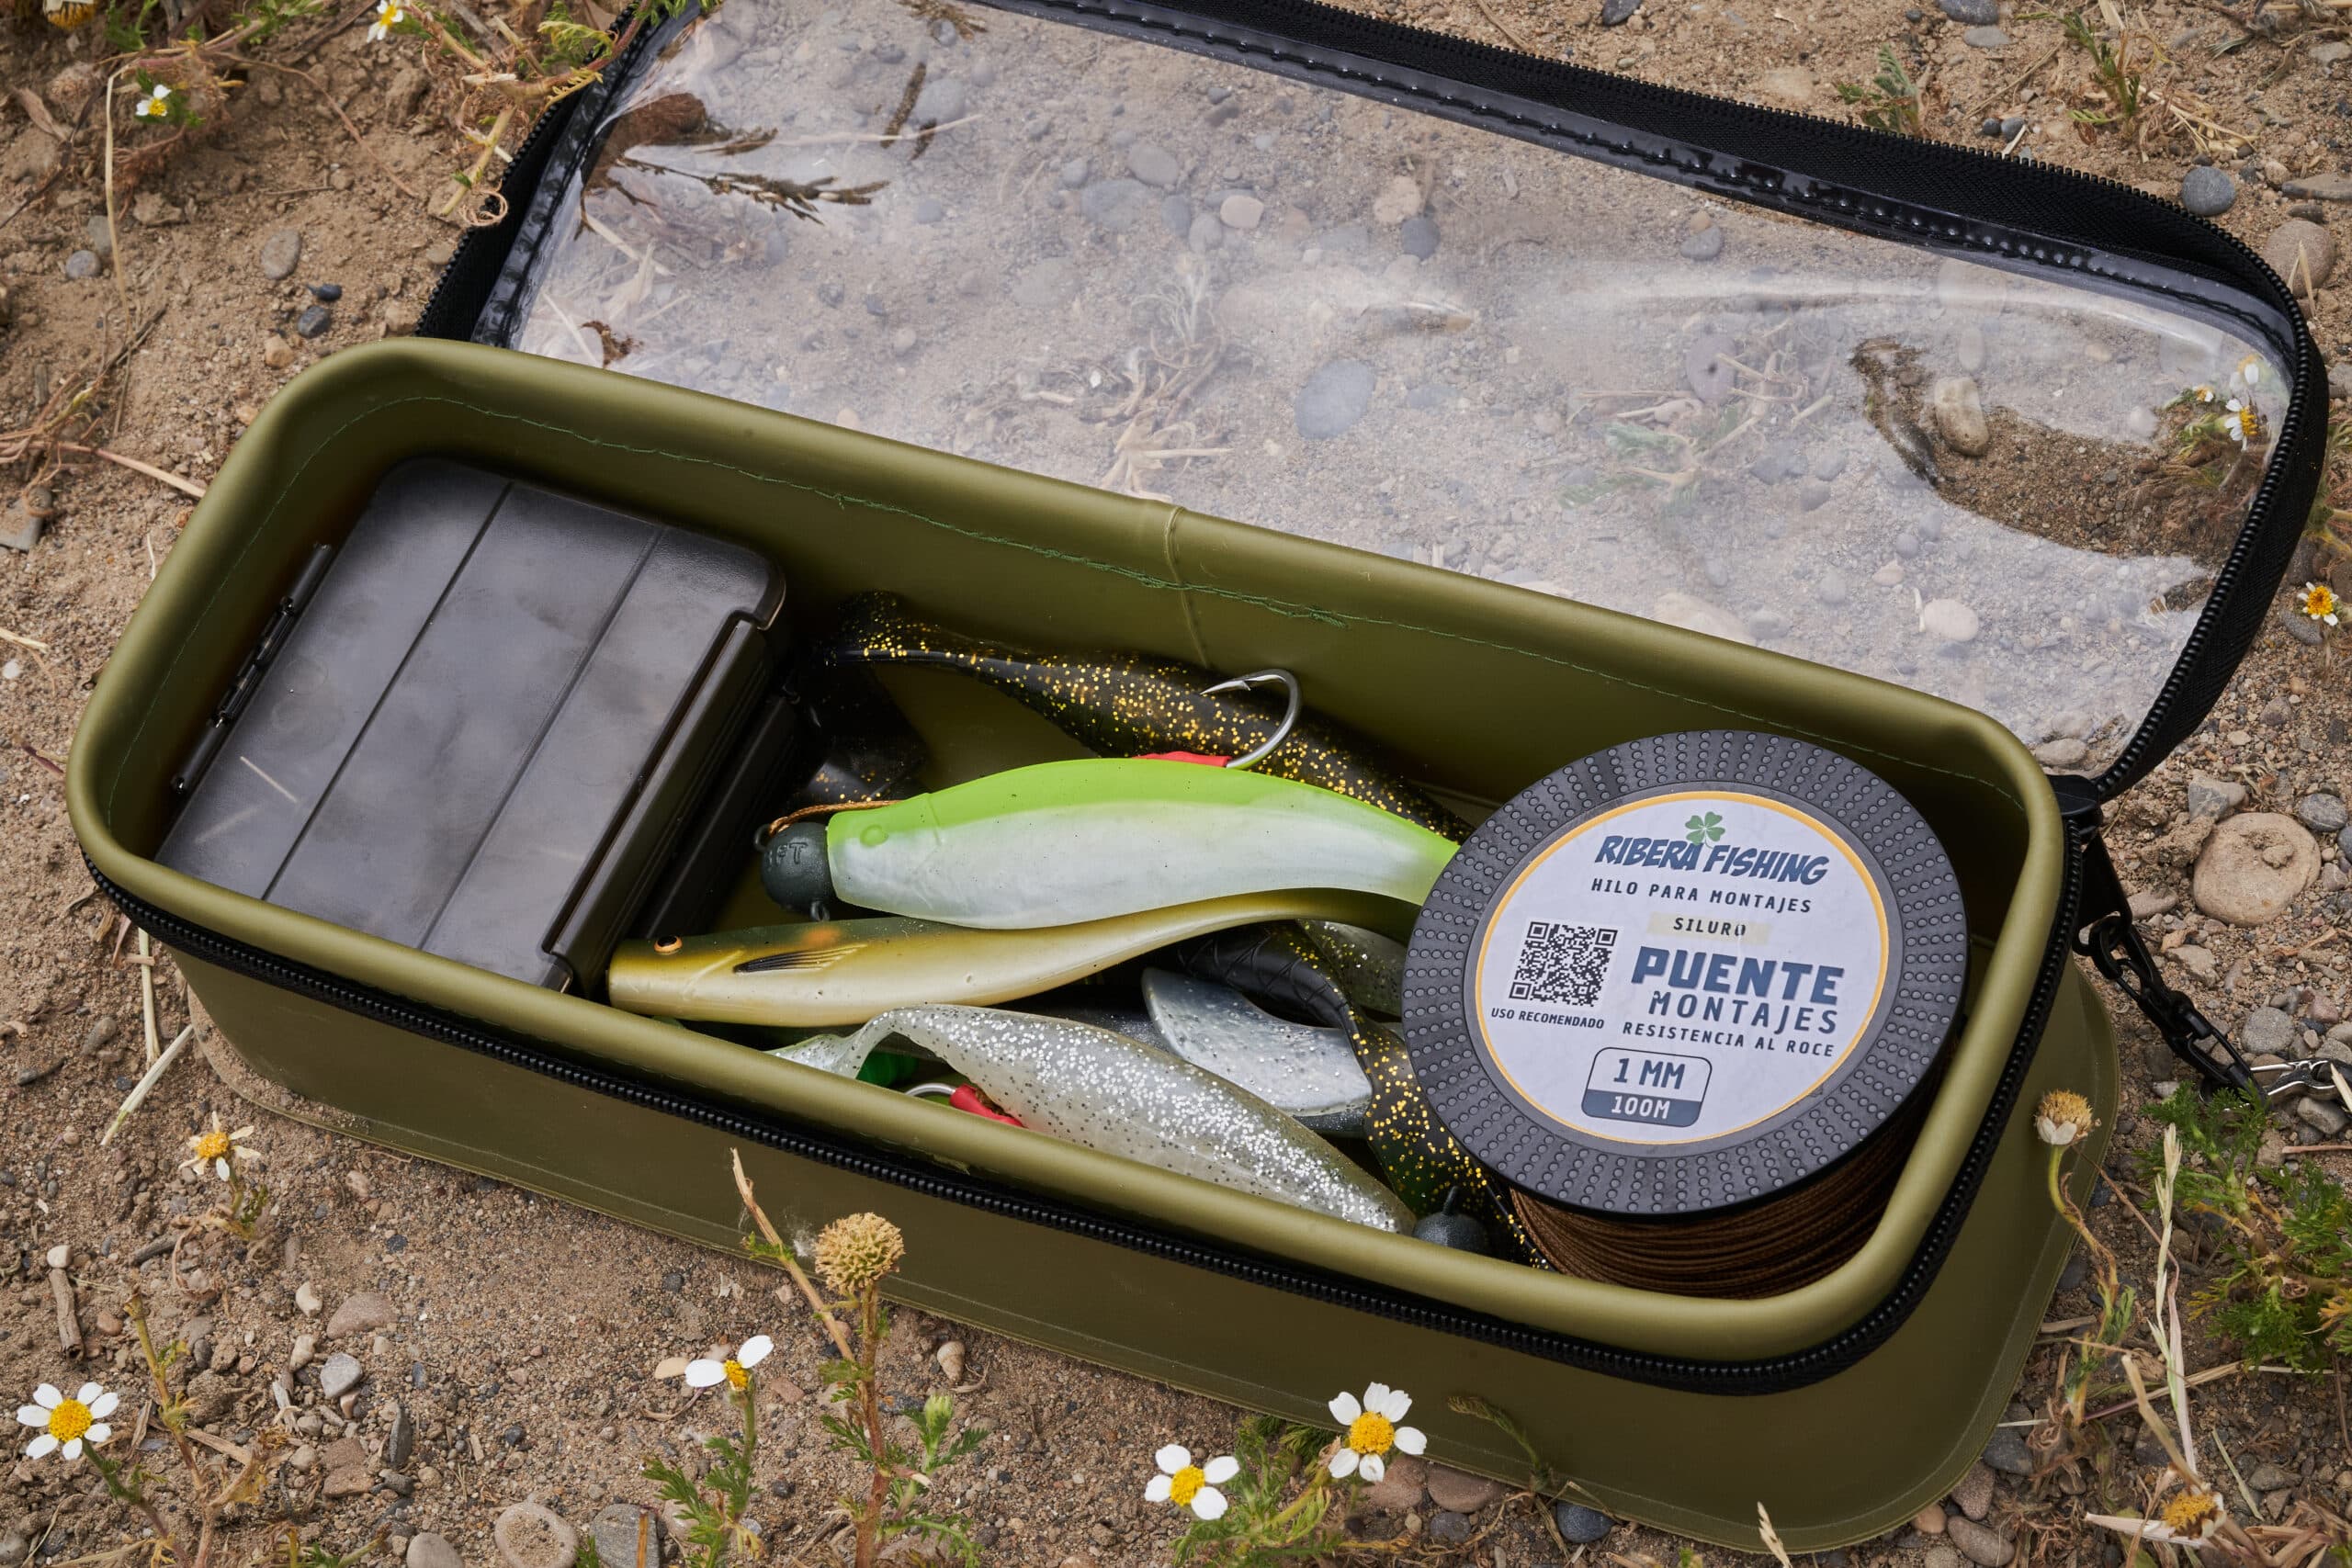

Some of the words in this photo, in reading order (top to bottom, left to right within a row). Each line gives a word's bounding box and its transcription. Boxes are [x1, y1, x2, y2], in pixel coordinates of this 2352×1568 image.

[1596, 835, 1703, 871] RIBERA
[1703, 843, 1829, 886] FISHING
[1591, 878, 1638, 895] HILO
[1648, 884, 1699, 901] PARA
[1709, 890, 1812, 913] MONTAJES
[1673, 917, 1747, 936] SILURO
[1631, 946, 1845, 1005] PUENTE
[1491, 1007, 1516, 1021] USO
[1518, 1010, 1605, 1029] RECOMENDADO
[1648, 990, 1838, 1034] MONTAJES
[1623, 1021, 1745, 1047] RESISTENCIA
[1755, 1036, 1776, 1051] AL
[1785, 1040, 1834, 1057] ROCE
[1613, 1057, 1630, 1083] 1
[1640, 1061, 1686, 1090] MM
[1611, 1096, 1671, 1119] 100M
